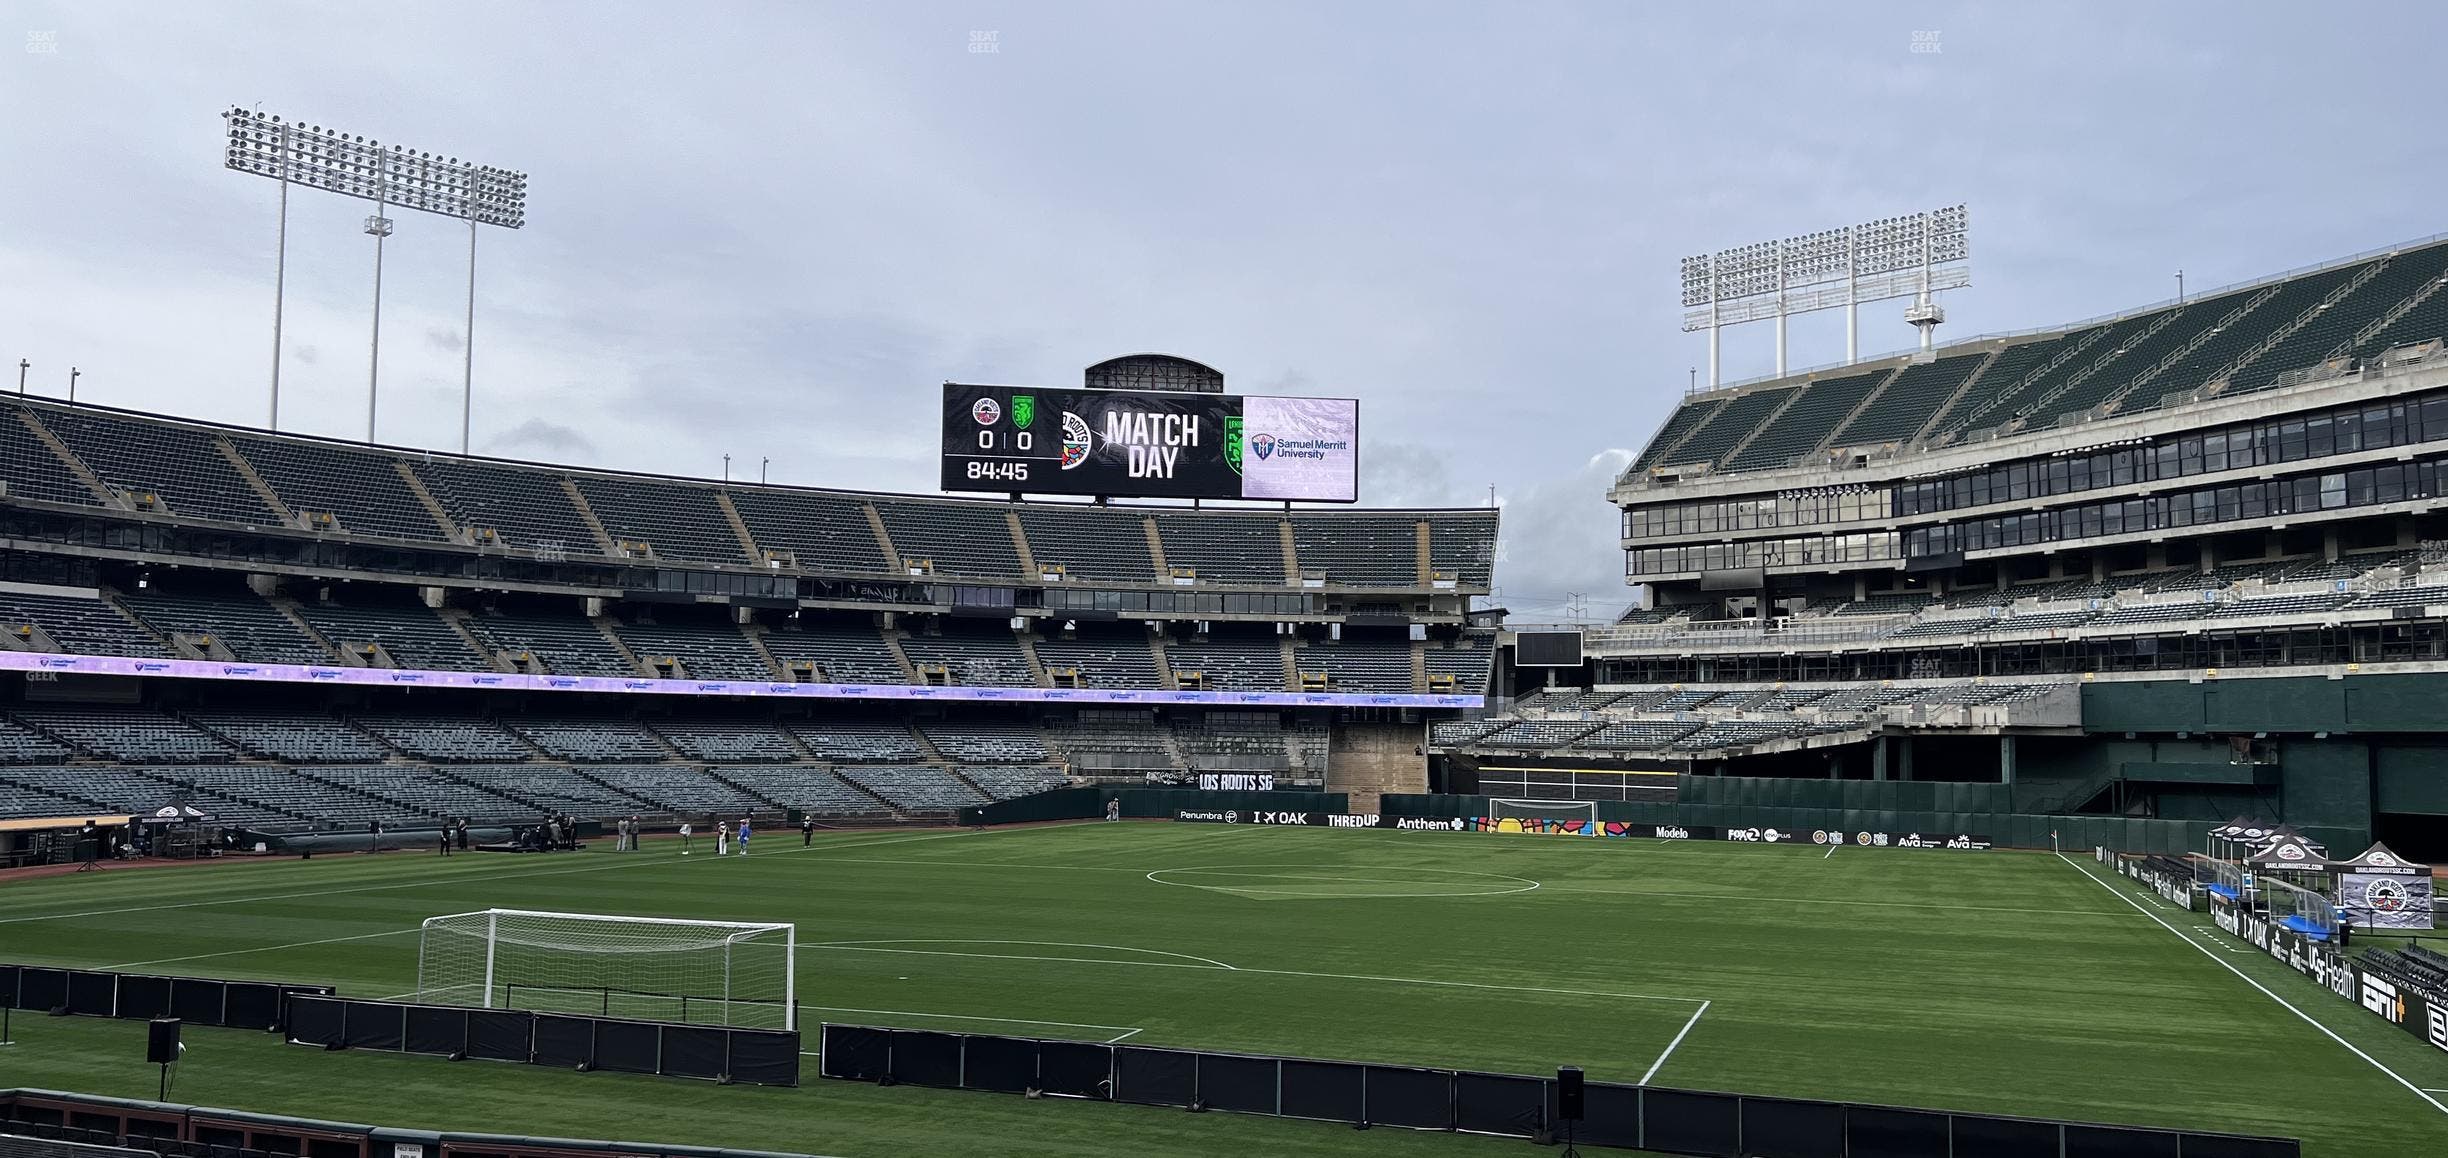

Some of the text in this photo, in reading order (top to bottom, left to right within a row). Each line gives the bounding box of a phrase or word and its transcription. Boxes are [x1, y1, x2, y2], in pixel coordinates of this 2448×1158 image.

[1068, 415, 1088, 443] ROOTS
[1106, 411, 1199, 447] MATCH
[979, 430, 1032, 450] 0 0
[1277, 439, 1347, 450] Samuel Merritt
[1128, 445, 1179, 479] DAY
[1277, 449, 1325, 461] University
[967, 461, 1028, 480] 84:45
[1199, 773, 1273, 791] LOS ROOTS SG
[1180, 811, 1223, 821] Penumbra
[1253, 811, 1308, 825] I OAK
[1327, 813, 1380, 828] THREDUP
[1397, 817, 1449, 830] Anthem
[1656, 826, 1688, 839] Modelo
[1727, 829, 1746, 841] FOX
[1898, 837, 1921, 848] Ava
[1946, 839, 1970, 849] Ava
[2254, 919, 2267, 950] OAK
[2309, 945, 2355, 1001] UCSF Health
[2363, 971, 2406, 1023] ESPN+
